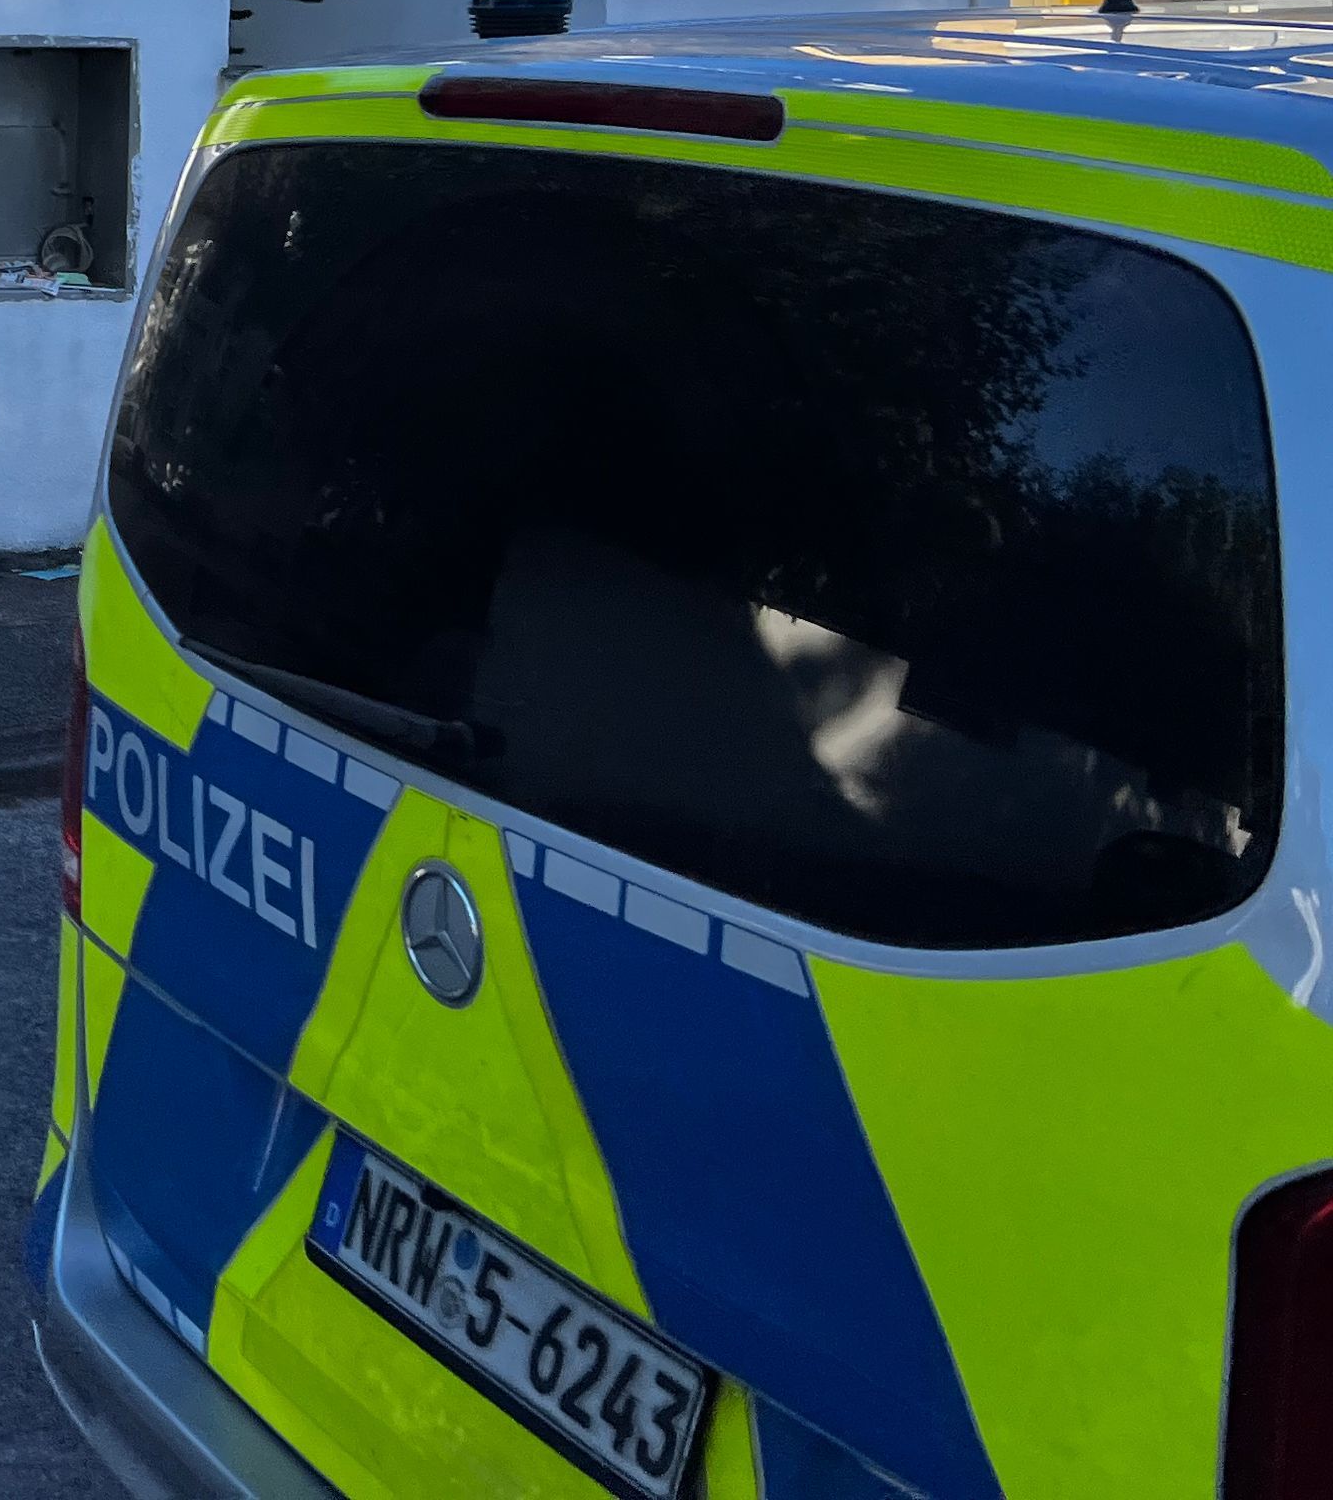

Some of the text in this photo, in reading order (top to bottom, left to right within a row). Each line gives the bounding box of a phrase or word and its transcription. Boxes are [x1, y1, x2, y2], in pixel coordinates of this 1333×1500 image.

[87, 705, 318, 949] POLIZEI
[343, 1167, 691, 1477] NRW 5-6243
